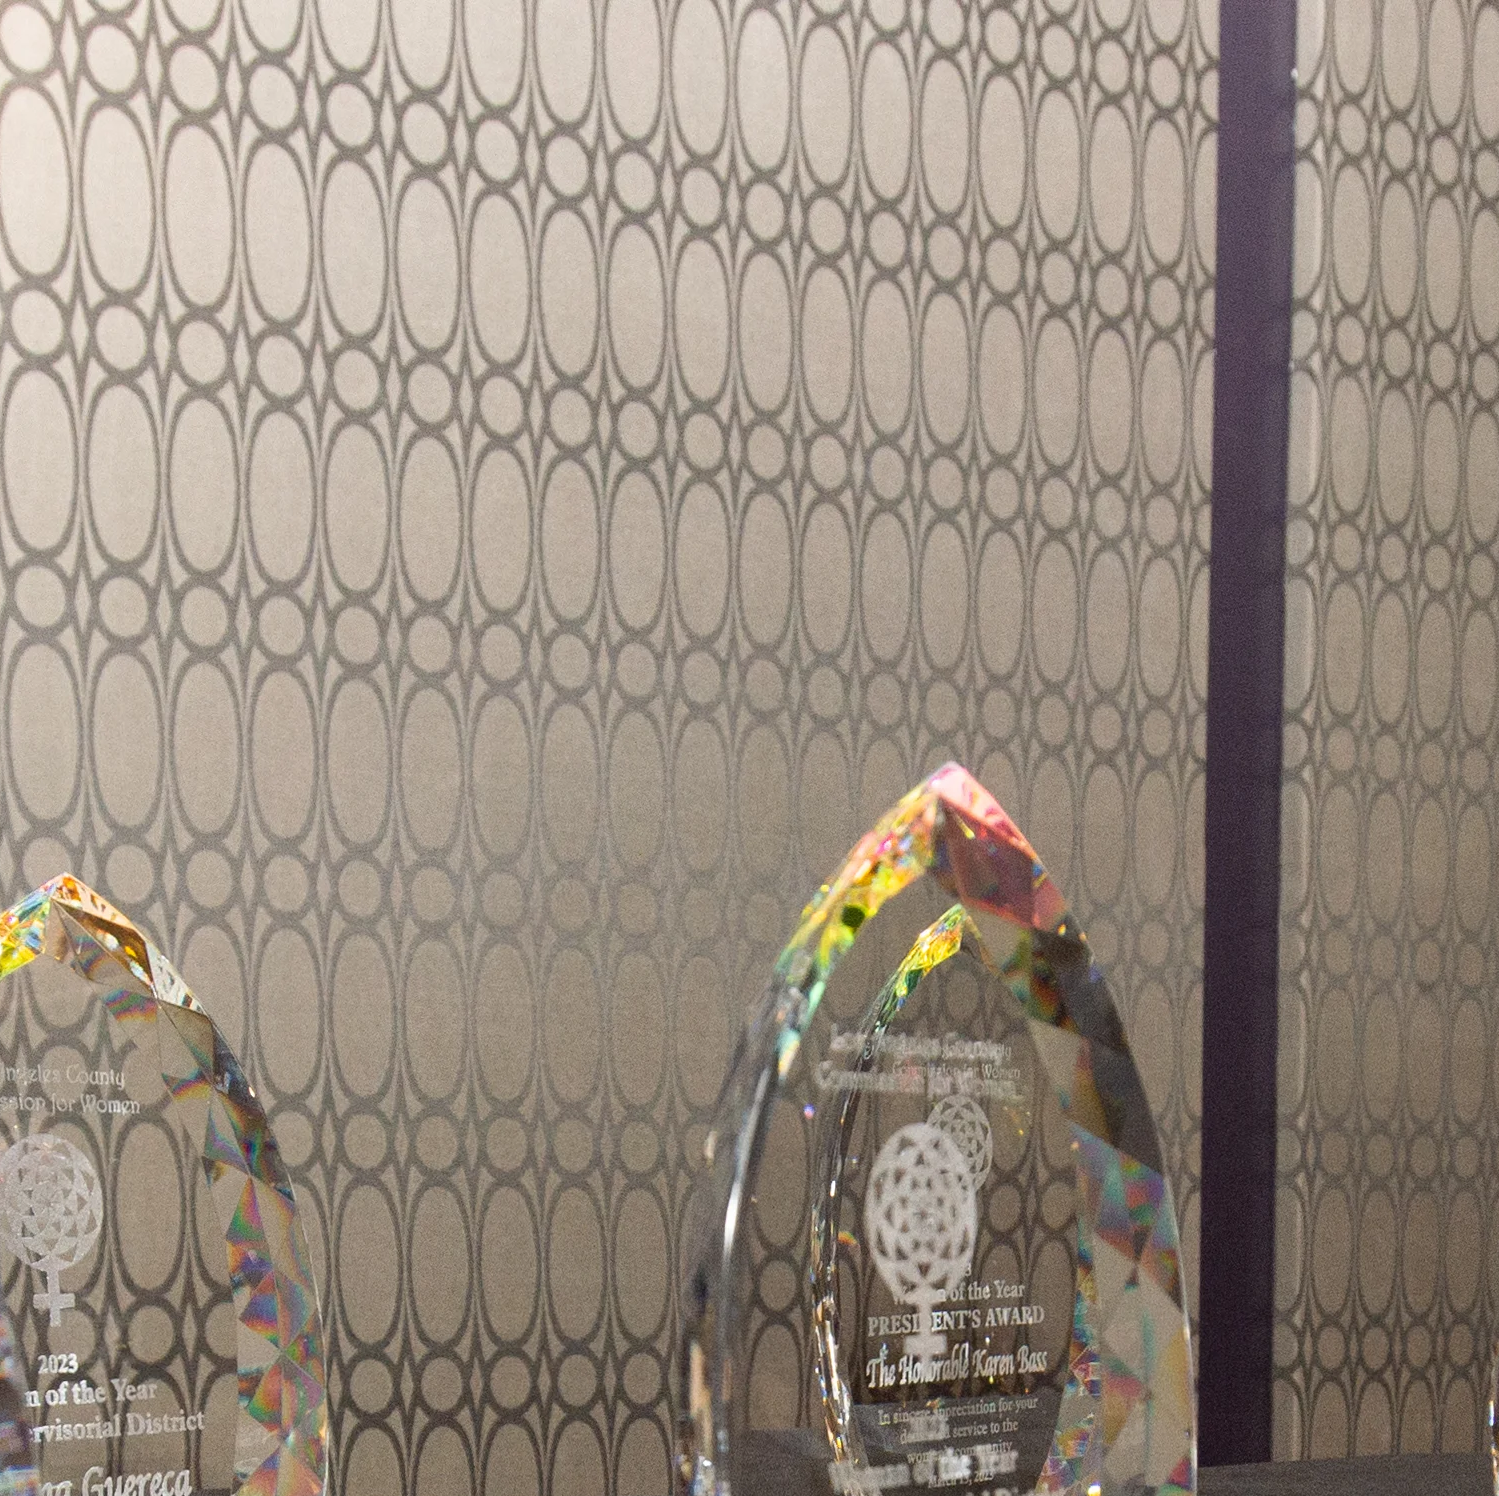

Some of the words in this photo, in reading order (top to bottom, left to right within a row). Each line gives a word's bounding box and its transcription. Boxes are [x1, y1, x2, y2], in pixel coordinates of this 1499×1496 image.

[67, 1064, 125, 1090] County
[50, 1093, 76, 1116] for
[80, 1093, 141, 1115] Women
[951, 1284, 966, 1302] of
[967, 1283, 991, 1300] the
[993, 1279, 1026, 1299] Year
[867, 1309, 981, 1337] PRESIENT'S
[985, 1305, 1045, 1327] AWARD
[38, 1353, 79, 1374] 2023
[866, 1343, 896, 1388] The
[972, 1349, 1015, 1377] Karen
[1017, 1345, 1048, 1374] Bass
[45, 1381, 69, 1406] of
[72, 1380, 105, 1404] the
[111, 1378, 158, 1401] Year
[126, 1409, 205, 1436] District
[878, 1410, 891, 1426] In
[998, 1398, 1012, 1415] for
[1015, 1397, 1038, 1413] your
[953, 1422, 988, 1439] service
[990, 1423, 1000, 1434] to
[1002, 1417, 1019, 1432] the
